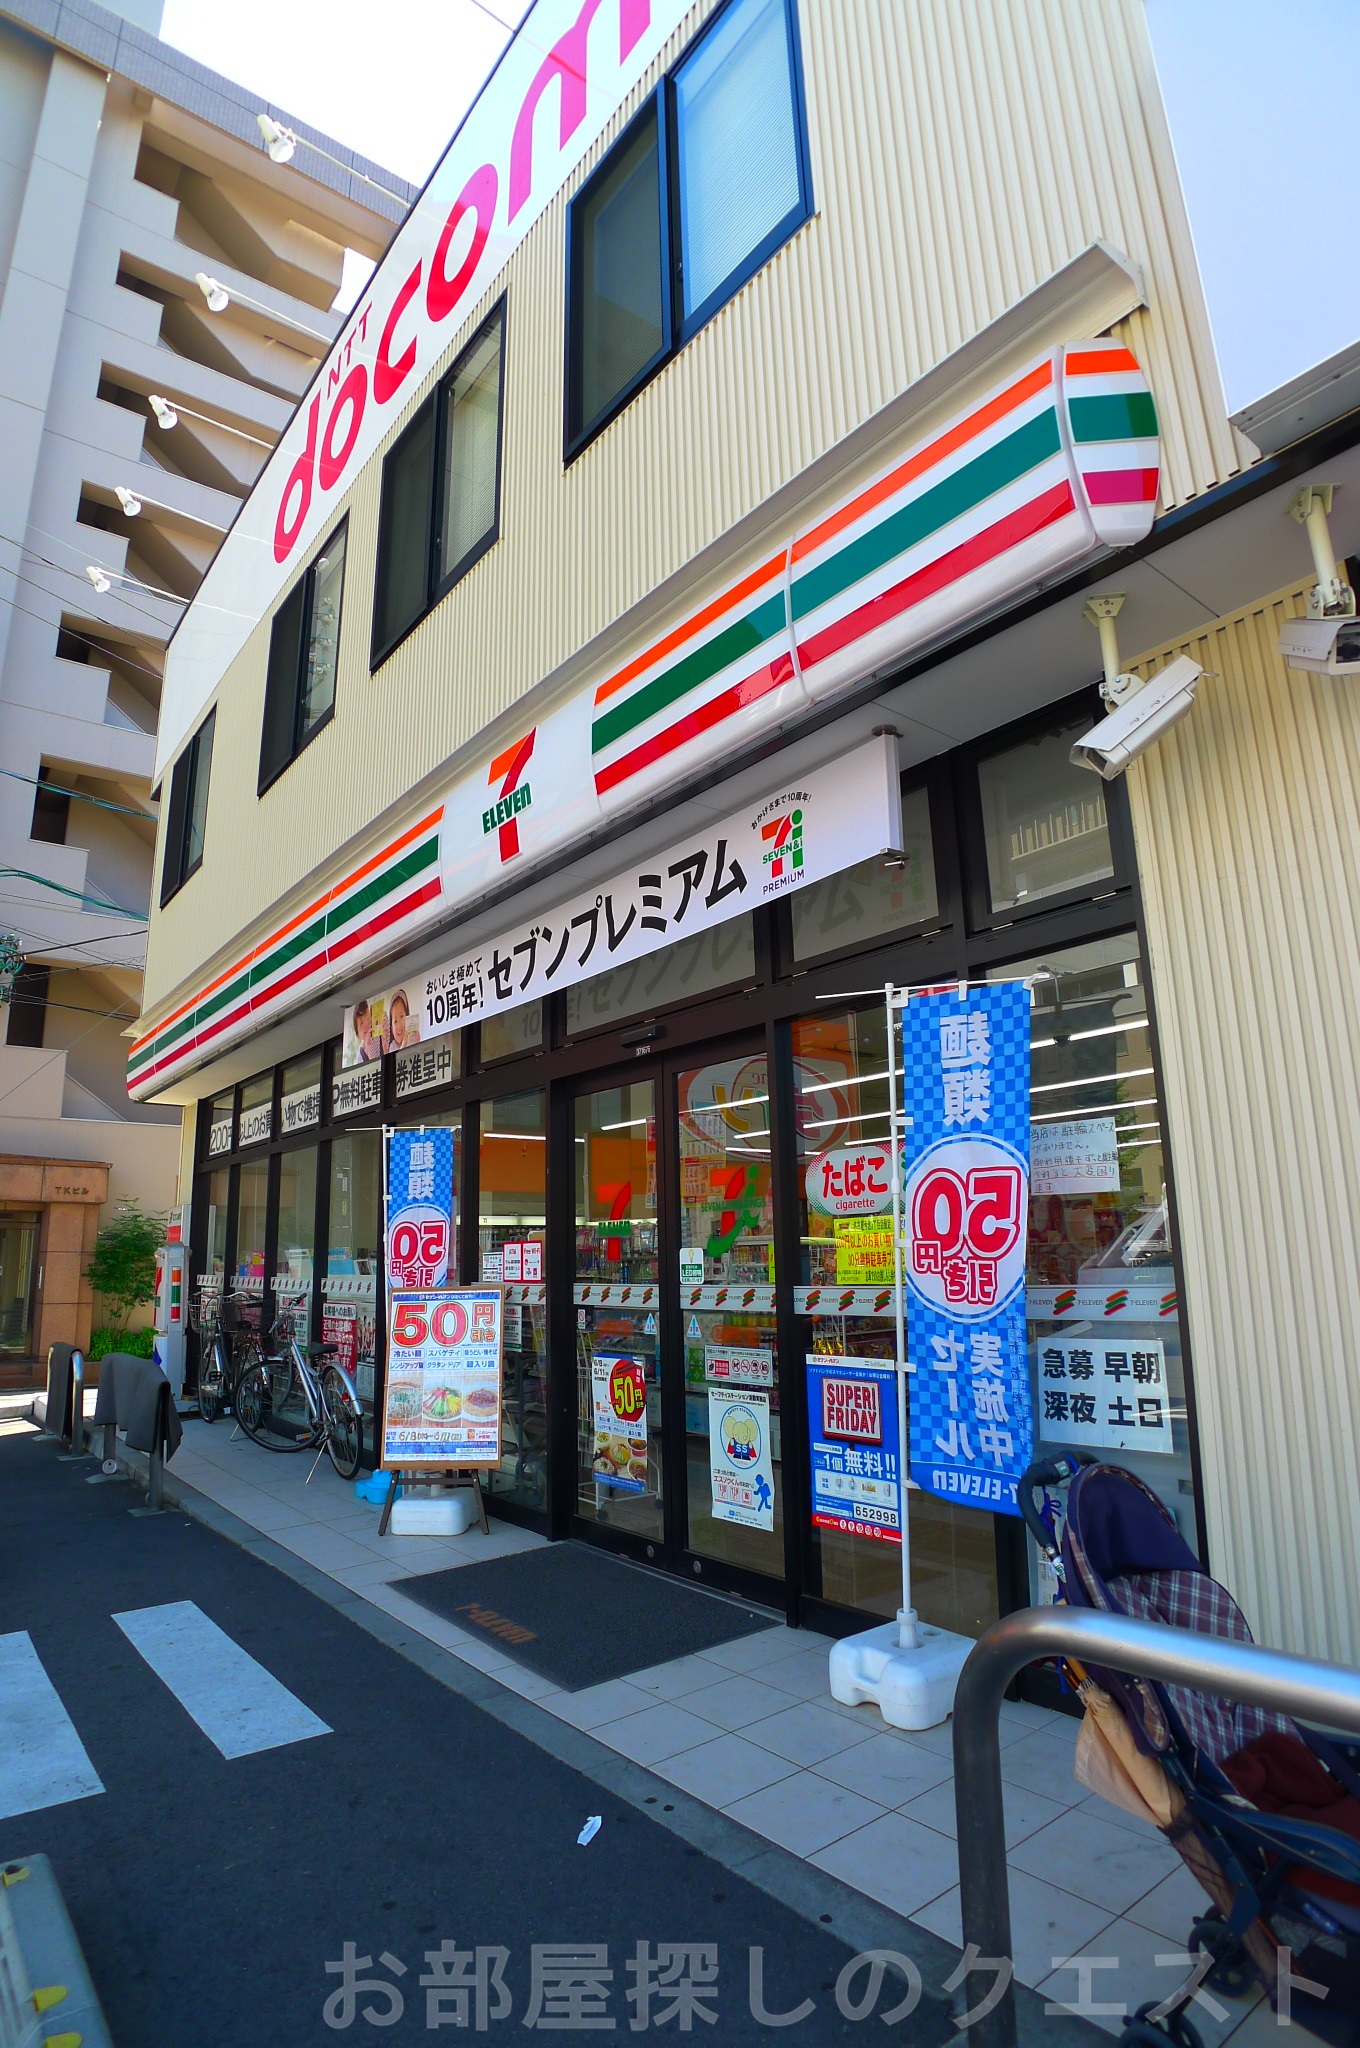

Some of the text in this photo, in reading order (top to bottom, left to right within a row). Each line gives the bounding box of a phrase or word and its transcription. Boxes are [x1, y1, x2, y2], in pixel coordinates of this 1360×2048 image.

[325, 300, 373, 399] NTT
[762, 868, 805, 896] PREMIUM
[487, 838, 748, 1000] セブンプレミアム
[426, 957, 483, 996] おいしさ極めて
[426, 976, 484, 1027] 10周年!
[397, 1045, 451, 1093] 券進呈中
[55, 1186, 89, 1195] TKビル
[822, 1155, 888, 1198] たばこ
[835, 1199, 875, 1211] cigarette
[1042, 1348, 1161, 1384] 急募 早朝
[827, 1406, 877, 1434] FRIDAY
[1043, 1390, 1164, 1428] 深夜 土日
[735, 1443, 748, 1454] SS
[855, 1505, 897, 1524] 652998
